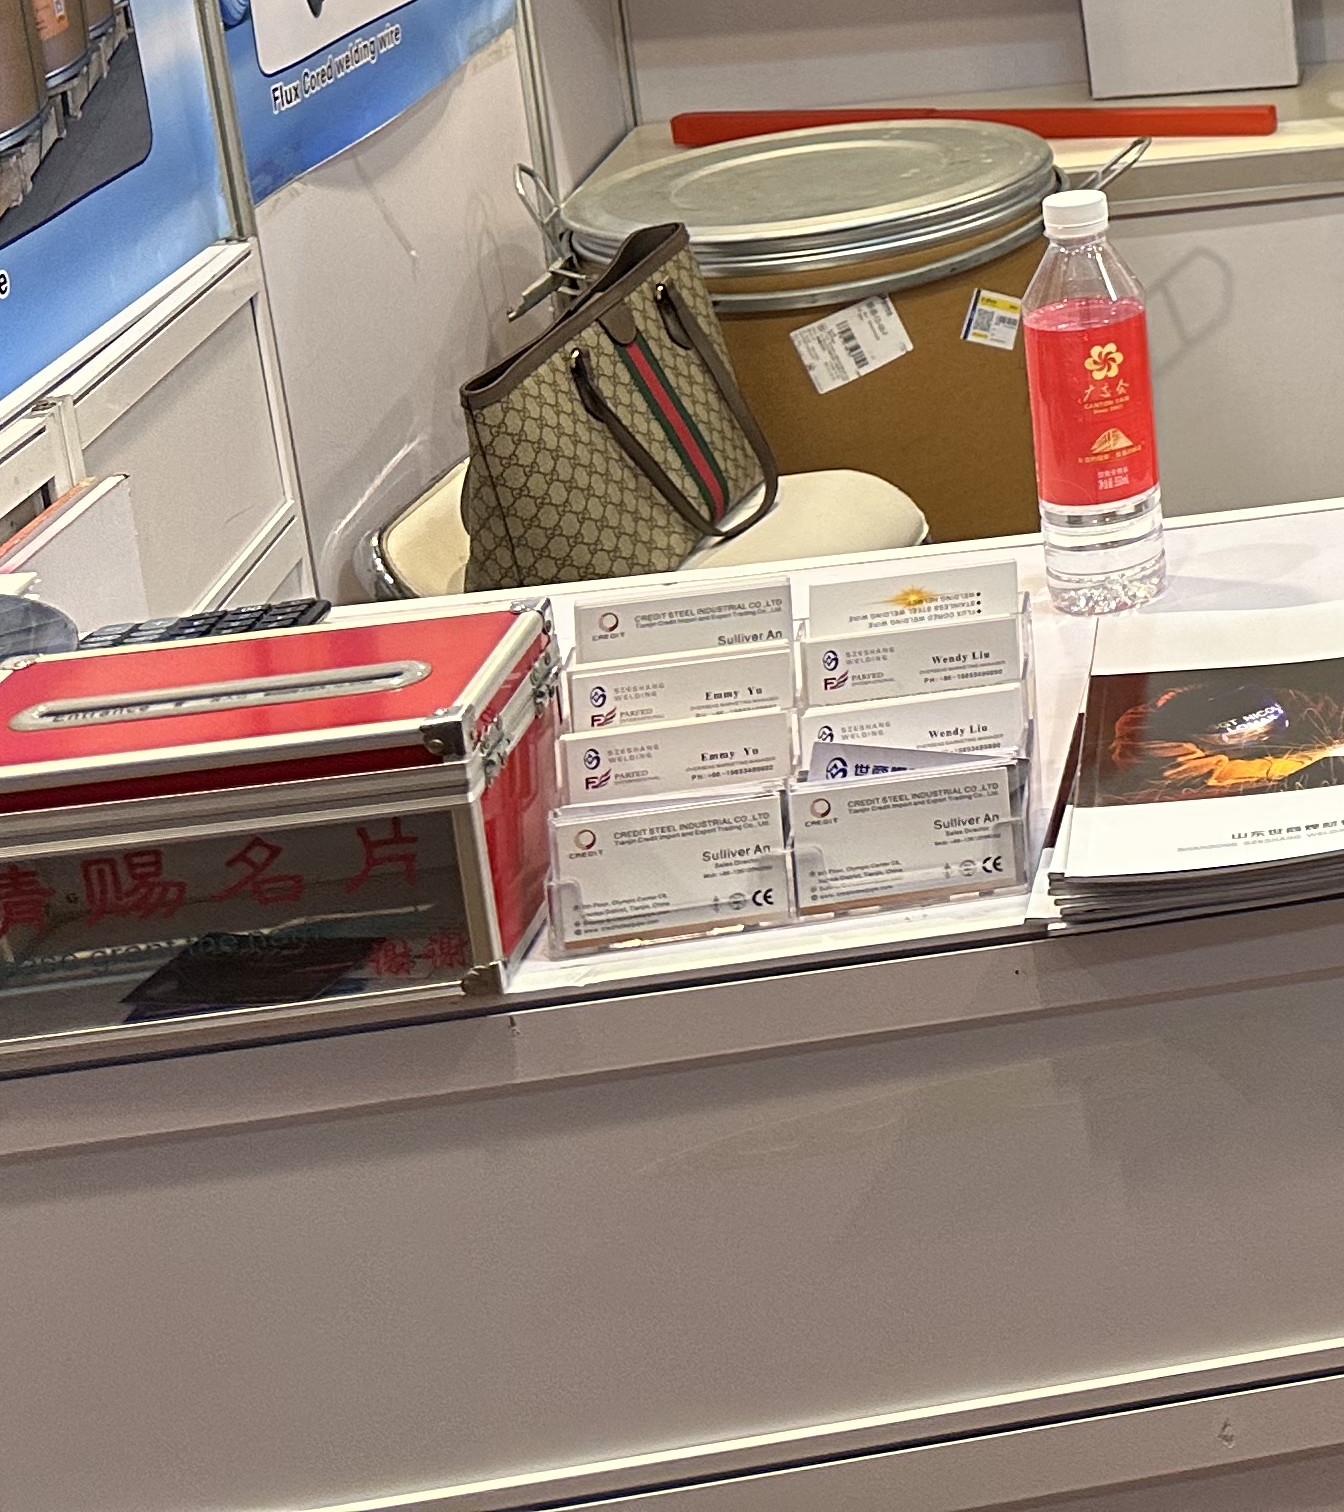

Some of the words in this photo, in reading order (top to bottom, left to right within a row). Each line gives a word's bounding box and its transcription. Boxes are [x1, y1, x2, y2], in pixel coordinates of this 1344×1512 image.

[271, 81, 301, 114] Flux
[302, 55, 334, 98] Cored
[333, 38, 378, 78] welding
[377, 23, 401, 53] wire
[634, 612, 667, 623] CREDIT
[668, 608, 695, 618] STEEL
[696, 602, 746, 616] INDUSTRIAL
[717, 632, 763, 646] Sulliver
[766, 630, 783, 639] An
[846, 656, 888, 665] WELDING
[932, 654, 968, 666] Wendy
[614, 691, 657, 702] WELDING
[705, 689, 740, 700] Emmy
[841, 729, 884, 740] WELDING
[929, 727, 966, 739] Wendy
[608, 753, 653, 763] WELDING
[701, 751, 735, 762] Emmy
[847, 798, 880, 808] CREDIT
[882, 794, 909, 804] STEEL
[911, 787, 962, 800] INDUSTRIAL
[805, 817, 838, 827] CREDIT
[934, 817, 980, 830] Sulliver
[984, 813, 999, 823] An
[613, 828, 647, 839] CREDIT
[649, 825, 677, 835] STEEL
[679, 817, 732, 831] INDUSTRIAL
[702, 848, 751, 862] Sulliver
[753, 844, 771, 854] An
